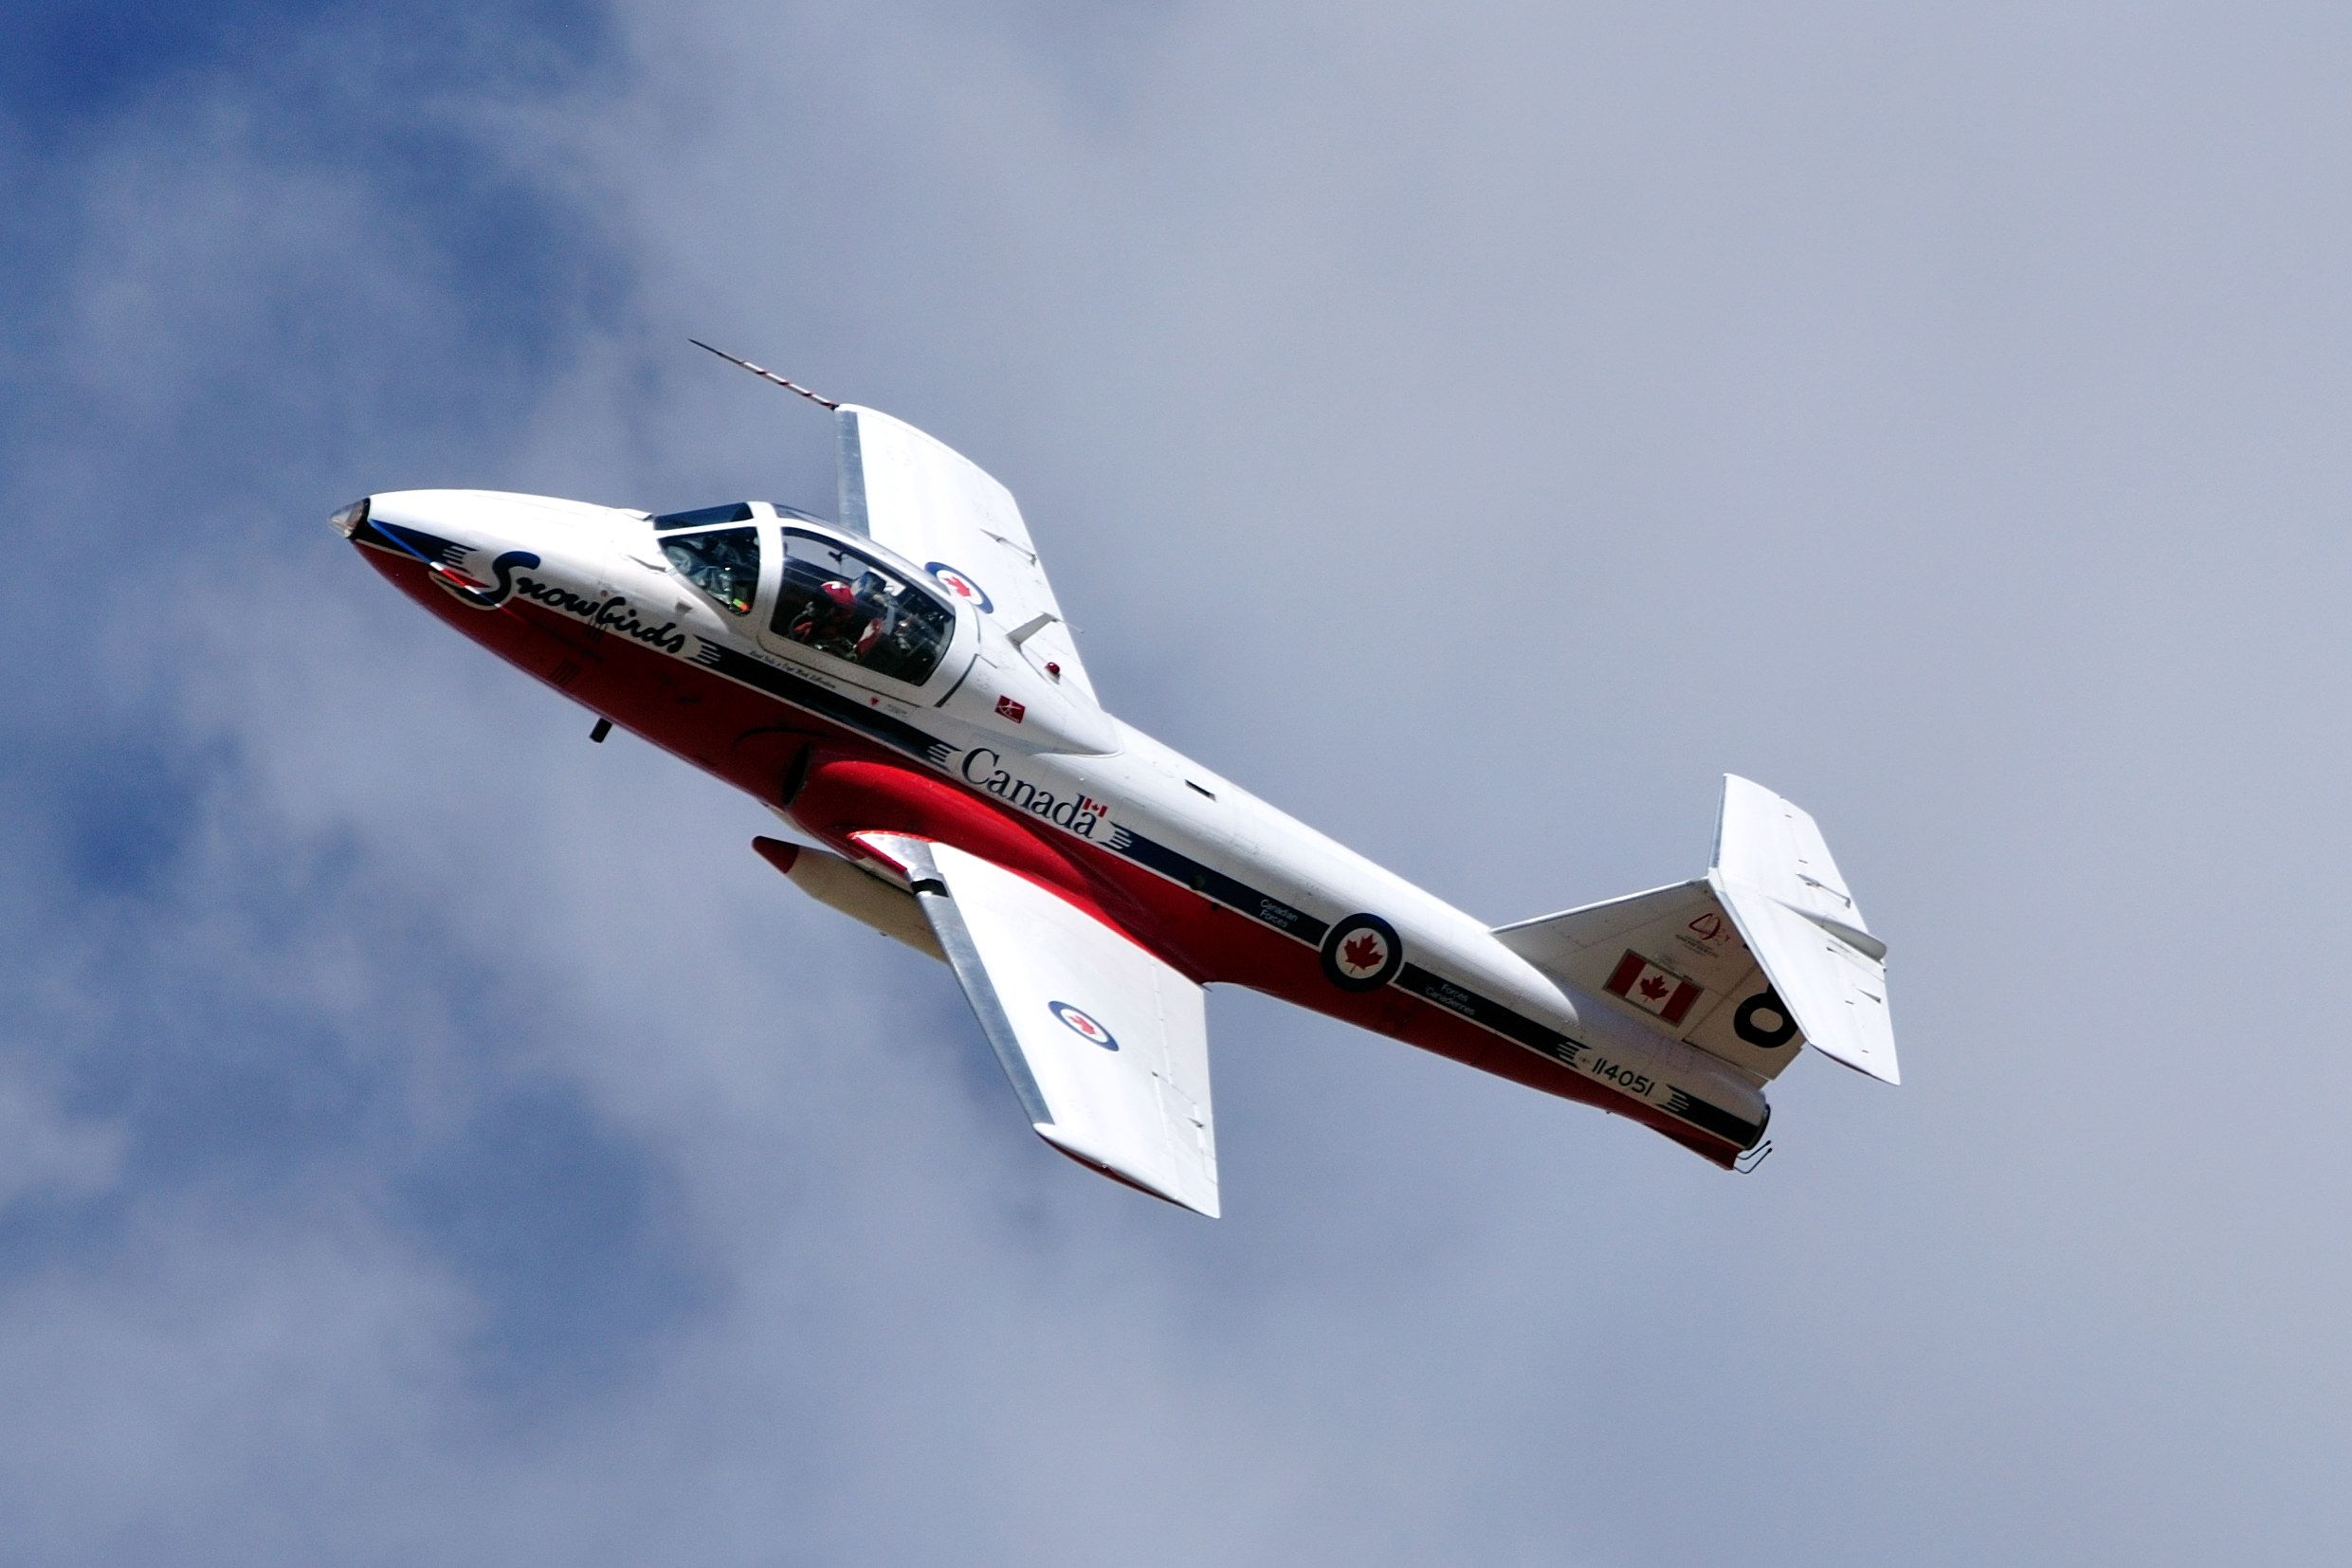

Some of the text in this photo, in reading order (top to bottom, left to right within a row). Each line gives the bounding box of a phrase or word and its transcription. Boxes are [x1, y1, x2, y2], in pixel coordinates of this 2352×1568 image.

[430, 550, 686, 654] Snowbirds
[961, 747, 1098, 839] Canada
[1592, 1057, 1655, 1097] 114051
